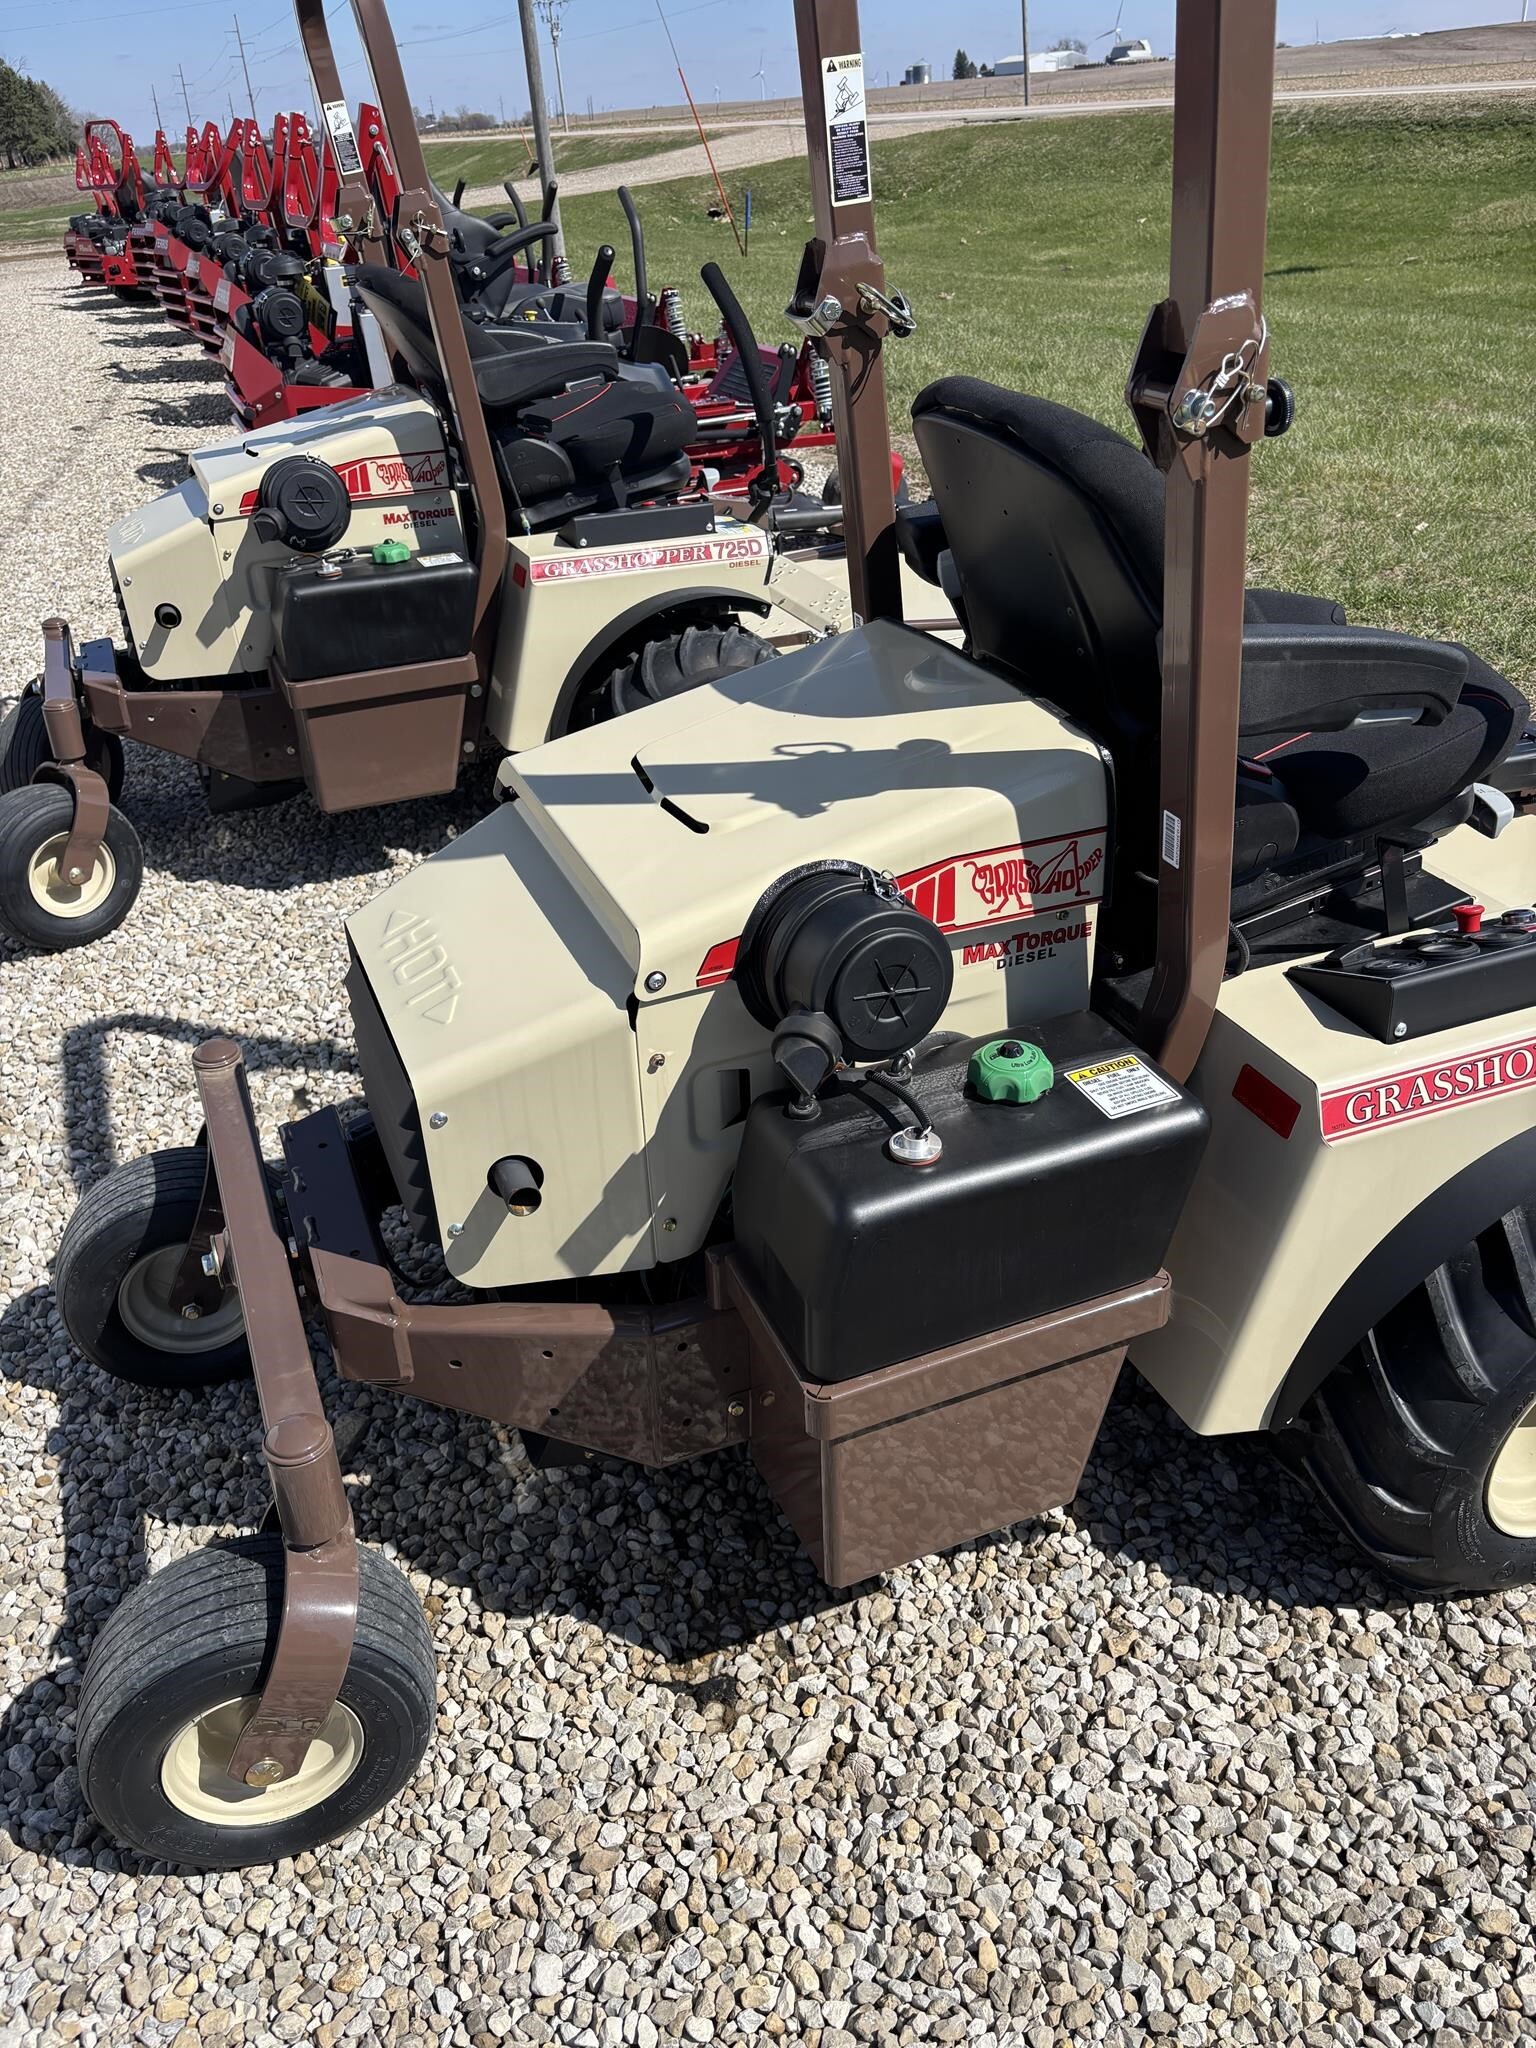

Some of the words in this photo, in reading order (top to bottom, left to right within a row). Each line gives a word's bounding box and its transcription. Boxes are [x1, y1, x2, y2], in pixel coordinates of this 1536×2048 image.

[838, 58, 861, 70] WARNING
[371, 456, 445, 490] GRASSHOPPER
[403, 520, 438, 530] DIESEL
[544, 544, 706, 578] GRASSHOPPER
[713, 539, 762, 560] 725D
[729, 559, 761, 568] DIESEL
[965, 841, 1104, 915] GRASSHOPPER
[378, 918, 462, 1007] HOT
[996, 947, 1057, 970] DIESEL
[1082, 1078, 1101, 1086] DIESEL
[1126, 1066, 1140, 1074] ONLY
[1089, 1058, 1133, 1076] CAUTION
[1345, 1046, 1536, 1124] GRASSHO
